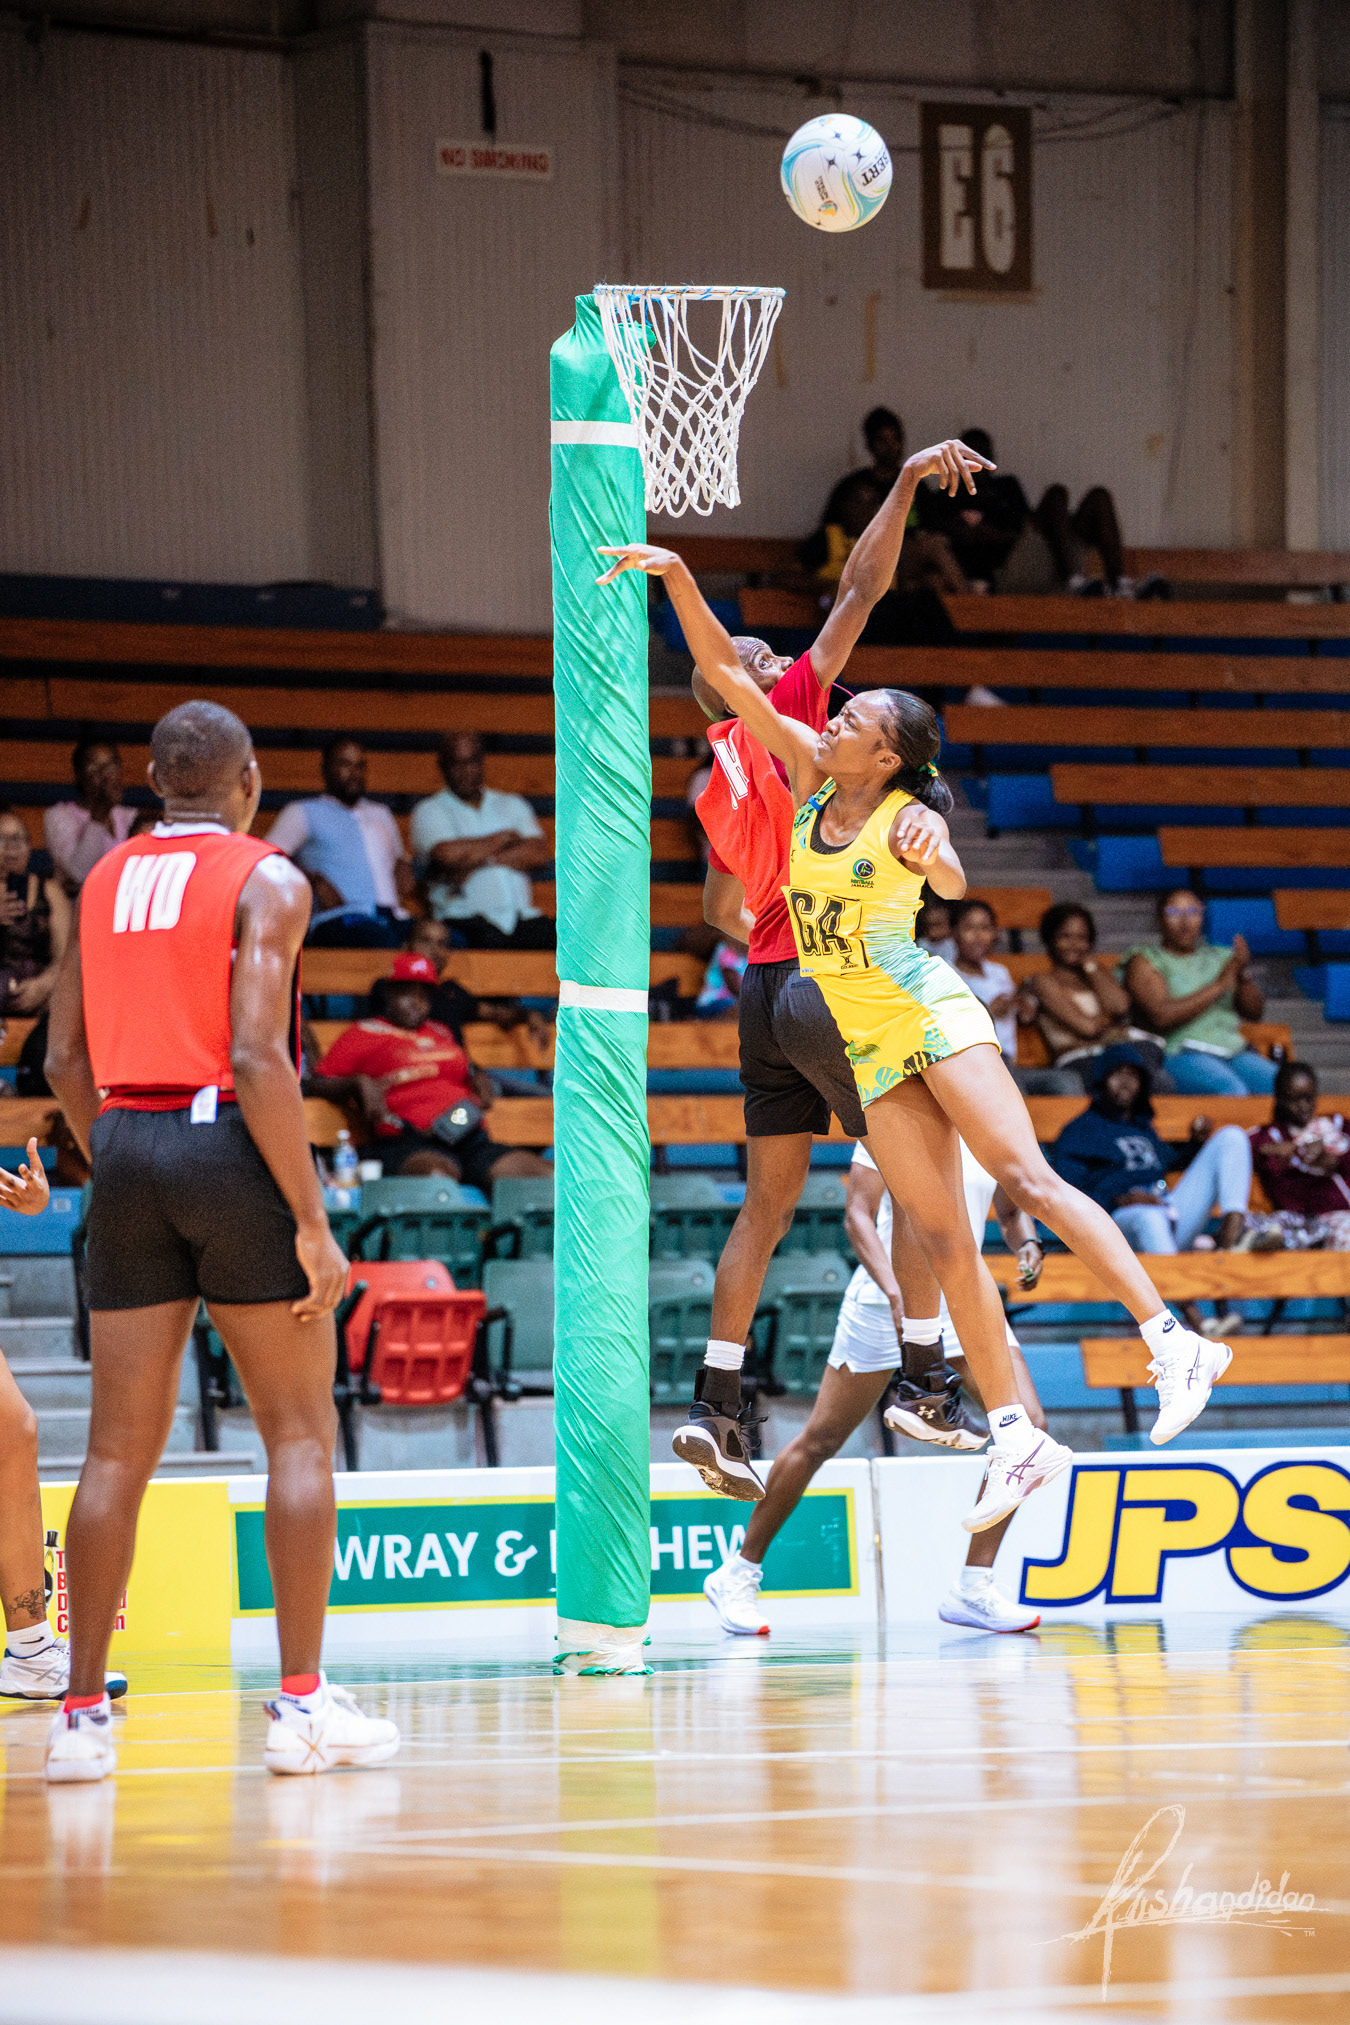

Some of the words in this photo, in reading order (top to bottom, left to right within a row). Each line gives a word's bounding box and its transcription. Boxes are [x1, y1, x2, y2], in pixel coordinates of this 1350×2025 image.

[938, 123, 1016, 274] E6
[112, 851, 197, 933] WD
[789, 888, 852, 956] GA
[334, 1531, 479, 1581] WRAY
[494, 1530, 538, 1577] &
[1018, 1460, 1350, 1608] JPS
